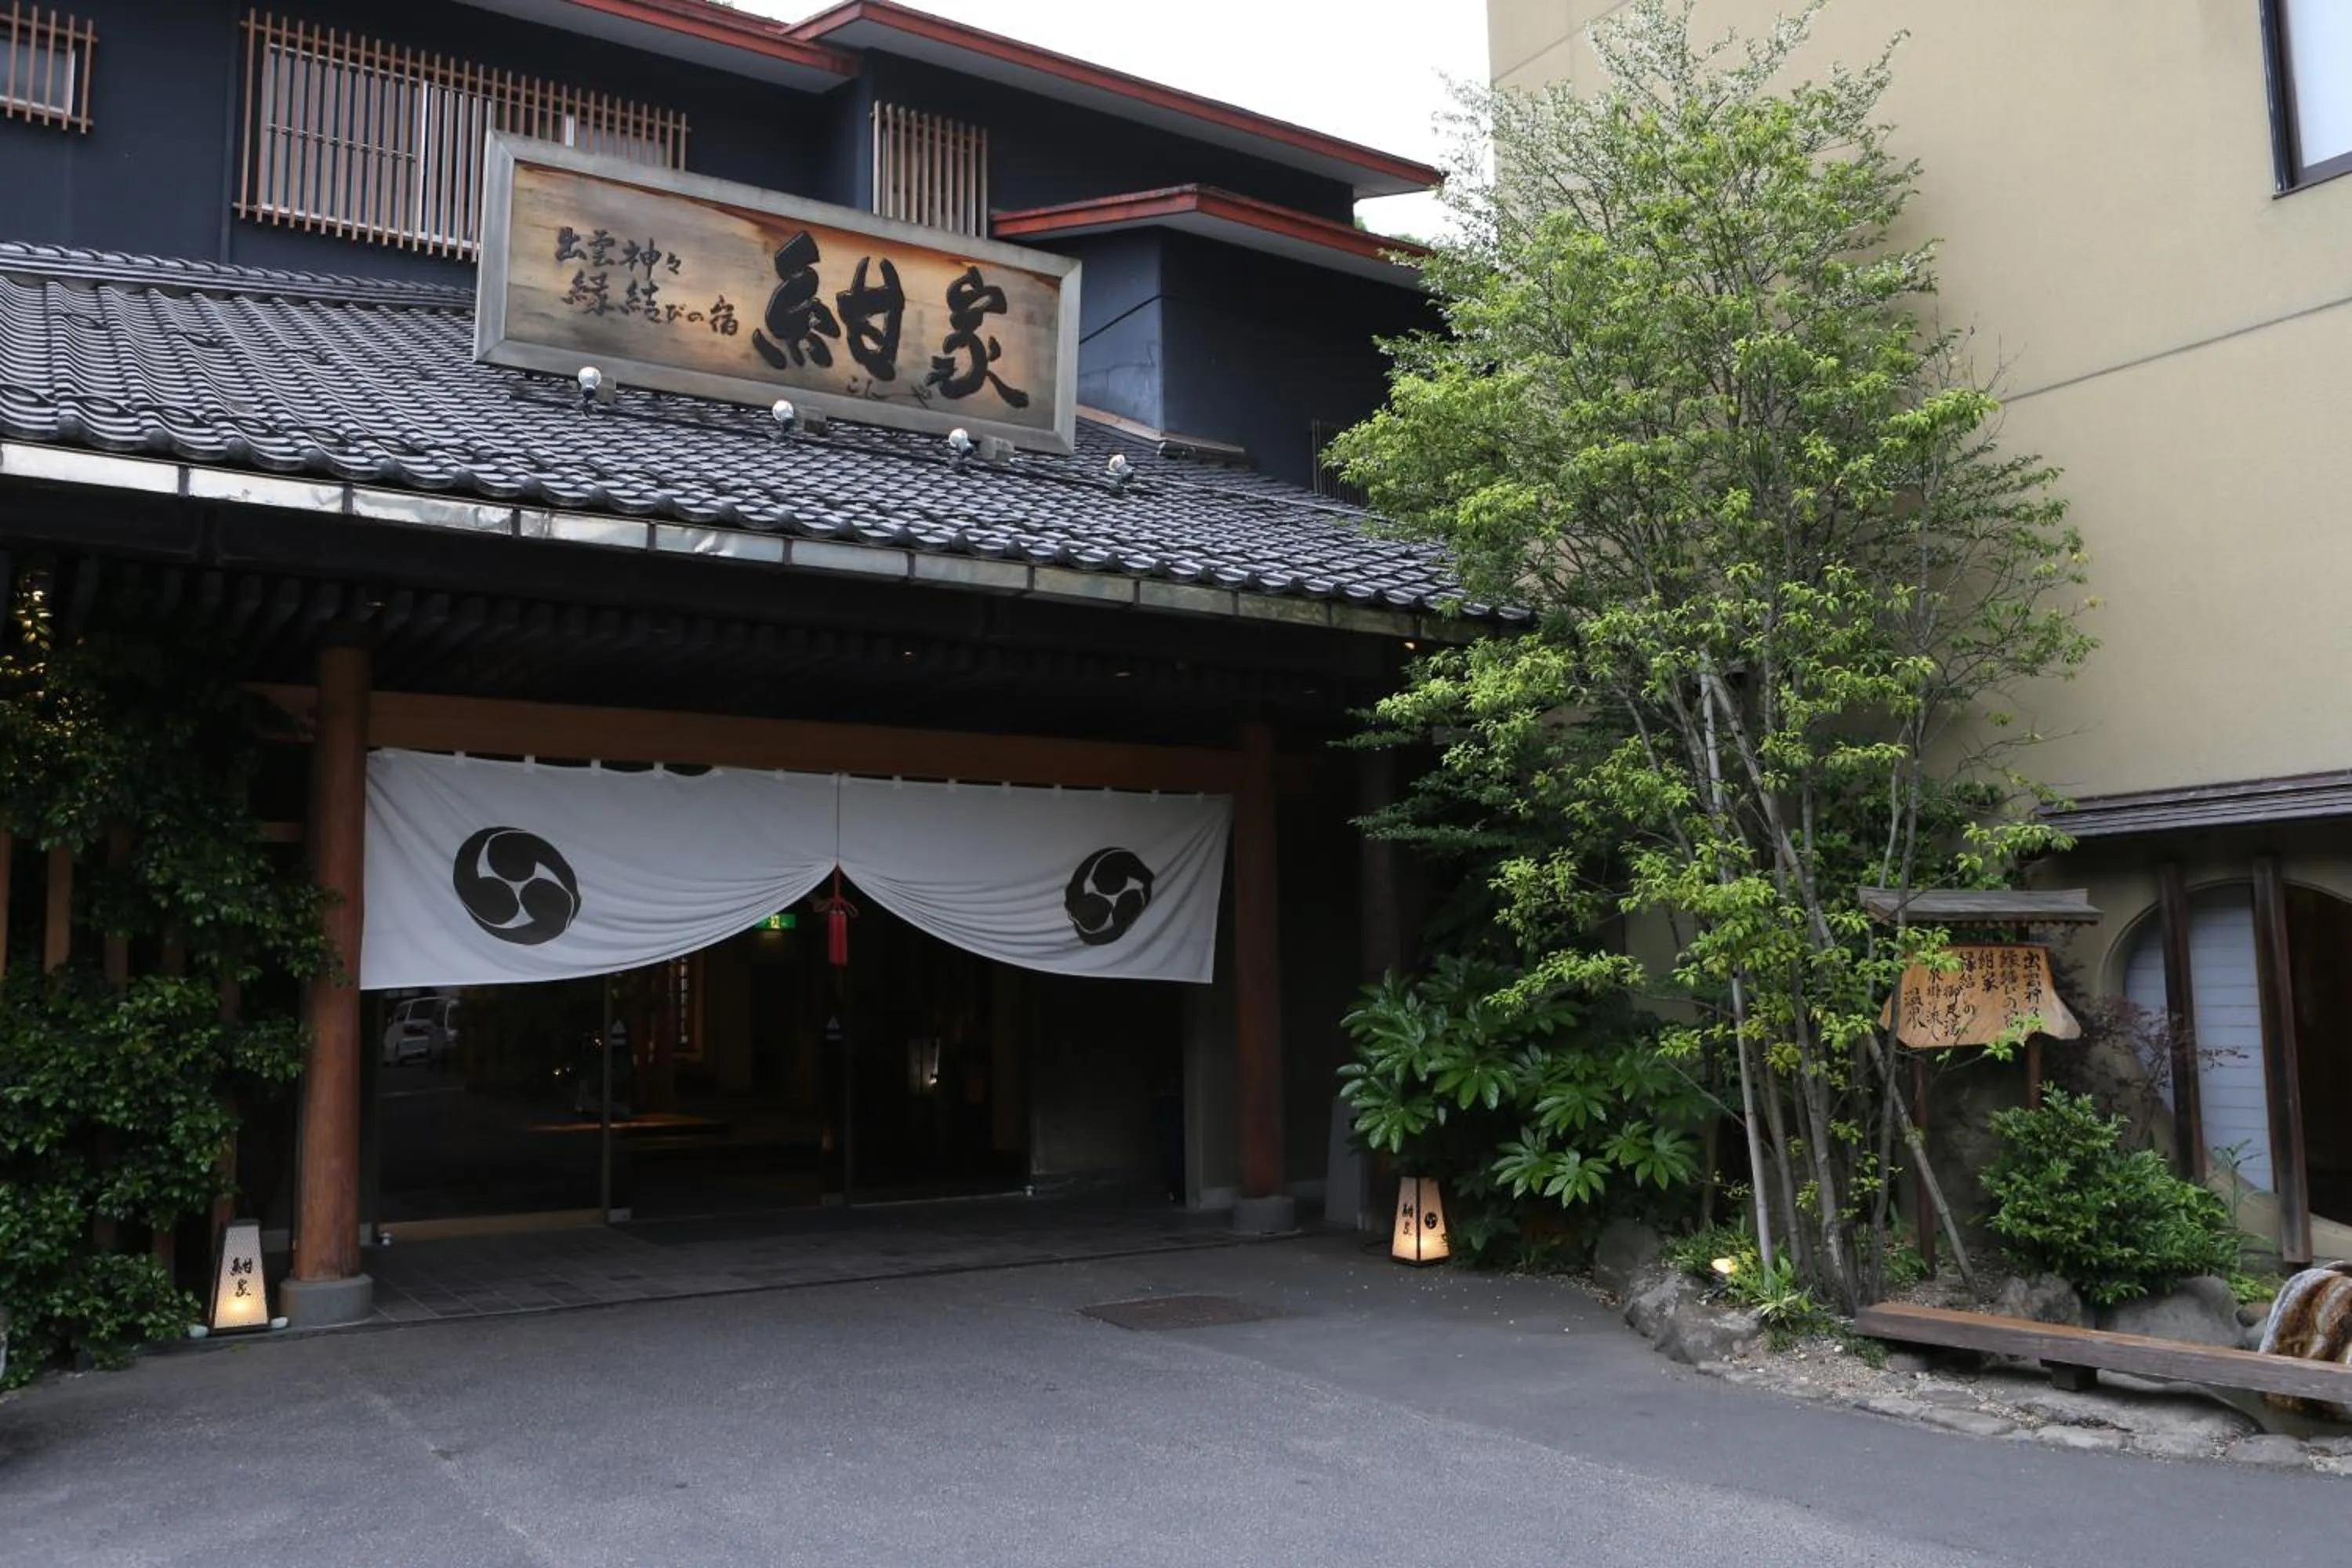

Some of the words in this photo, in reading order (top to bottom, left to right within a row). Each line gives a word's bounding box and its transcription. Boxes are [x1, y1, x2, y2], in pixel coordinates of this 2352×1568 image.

[555, 227, 681, 280] 出雲神々
[753, 230, 1029, 408] 紺家
